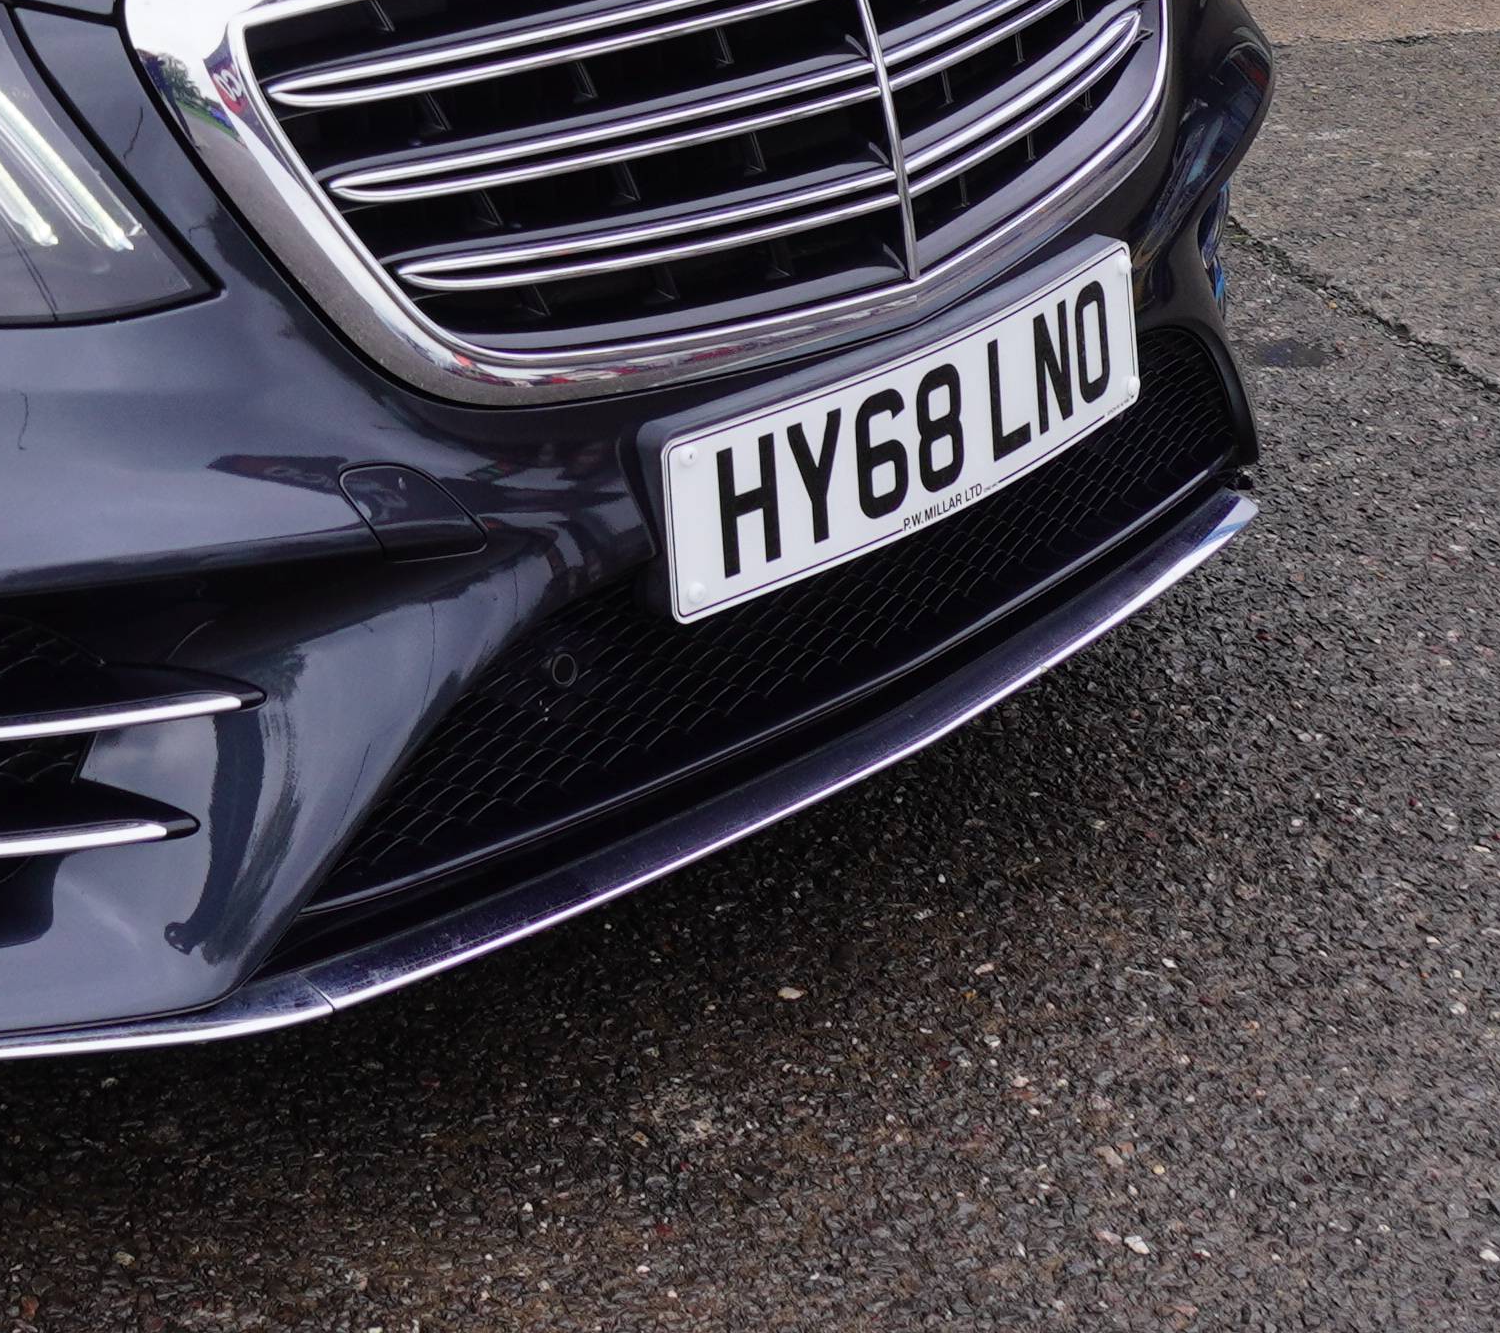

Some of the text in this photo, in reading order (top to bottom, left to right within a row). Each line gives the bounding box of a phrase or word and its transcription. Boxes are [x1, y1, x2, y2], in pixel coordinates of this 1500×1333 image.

[715, 280, 1111, 579] HY68 LNO
[964, 483, 983, 503] LTD
